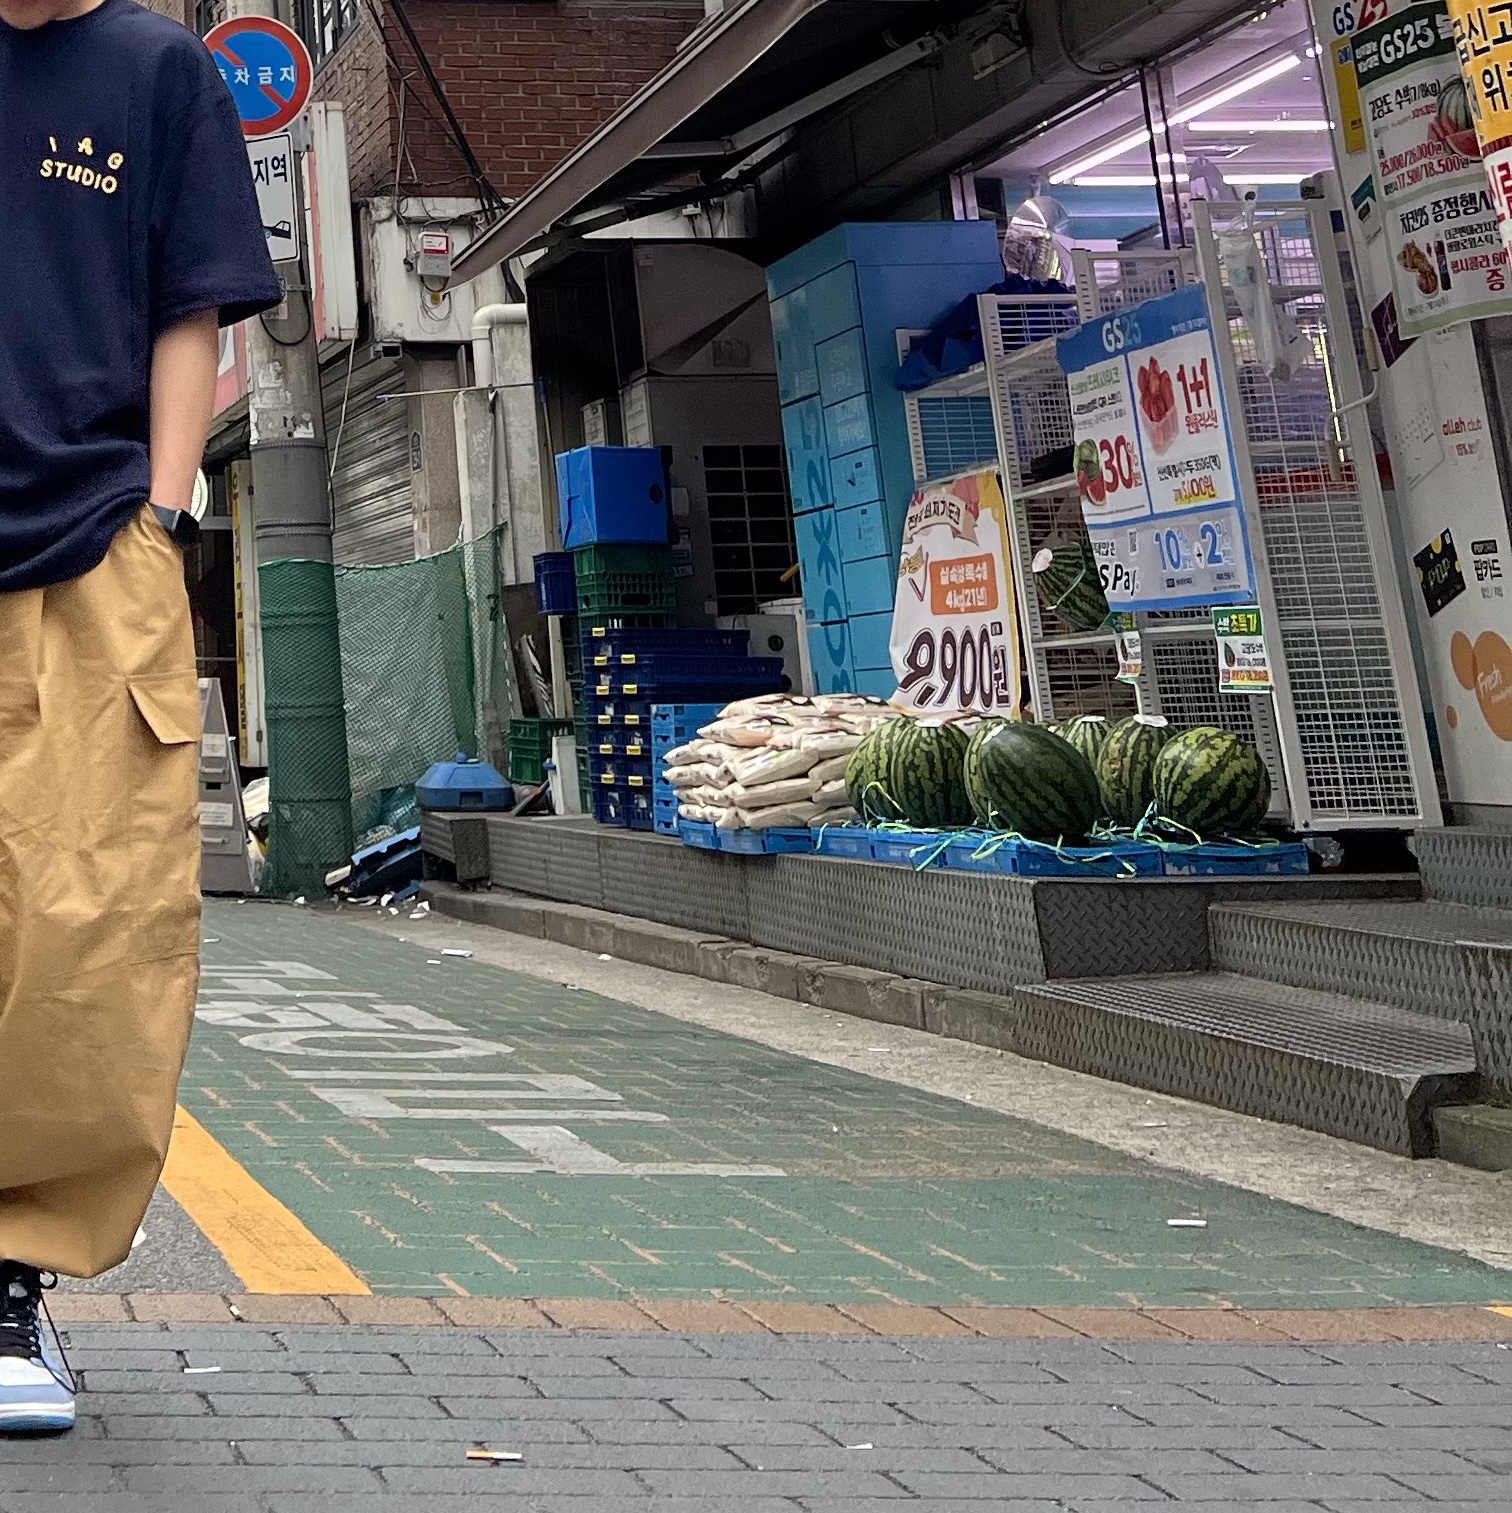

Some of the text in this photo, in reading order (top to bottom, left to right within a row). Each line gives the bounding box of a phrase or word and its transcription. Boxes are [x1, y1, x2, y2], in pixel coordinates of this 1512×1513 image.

[1379, 18, 1435, 64] GS25
[1482, 63, 1512, 112] 위
[40, 159, 118, 194] STUDIO
[254, 153, 288, 186] 지역
[1102, 314, 1143, 353] GS25
[1177, 358, 1213, 414] 1+1
[1230, 612, 1258, 633] 초특가
[898, 623, 1010, 708] 9,900원
